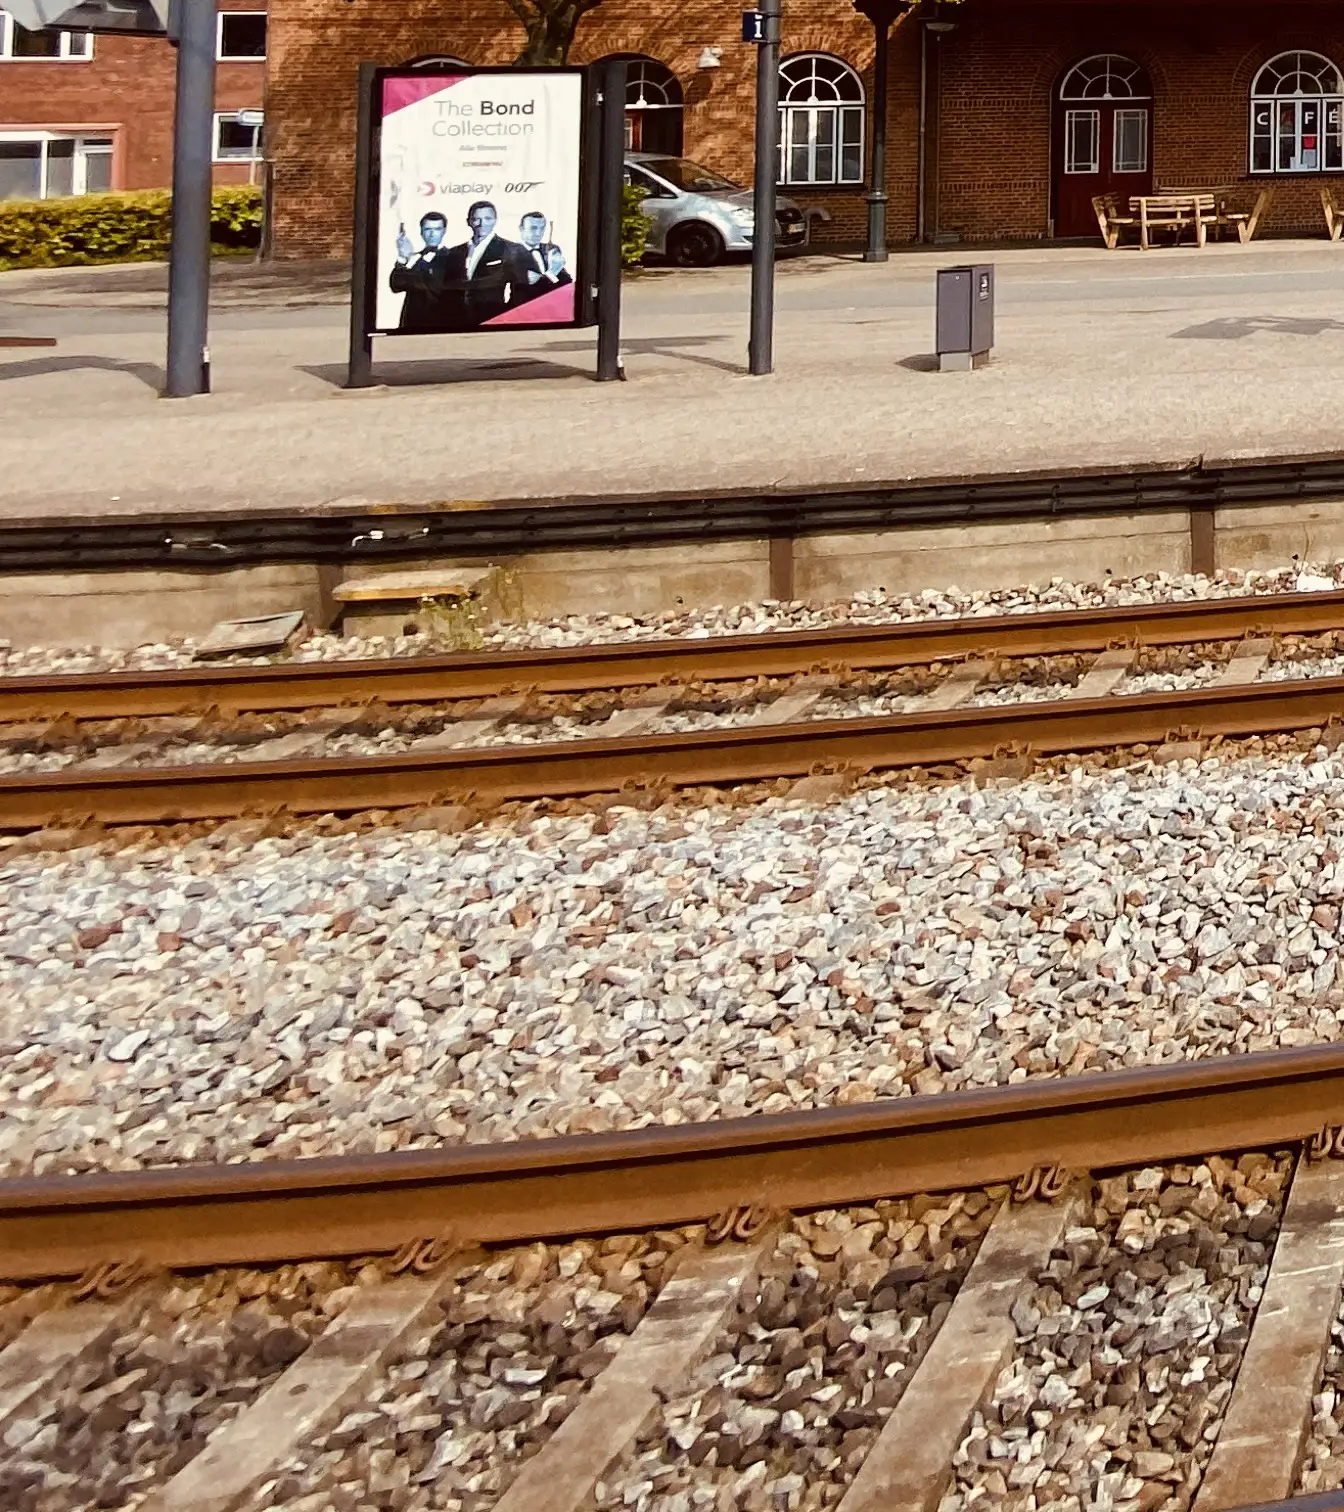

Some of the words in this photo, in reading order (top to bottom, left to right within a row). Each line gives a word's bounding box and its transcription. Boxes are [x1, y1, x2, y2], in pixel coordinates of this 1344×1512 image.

[434, 100, 473, 117] The
[480, 99, 535, 116] Bond
[432, 120, 534, 137] Collection
[440, 182, 494, 195] viaplay
[504, 181, 545, 193] 007
